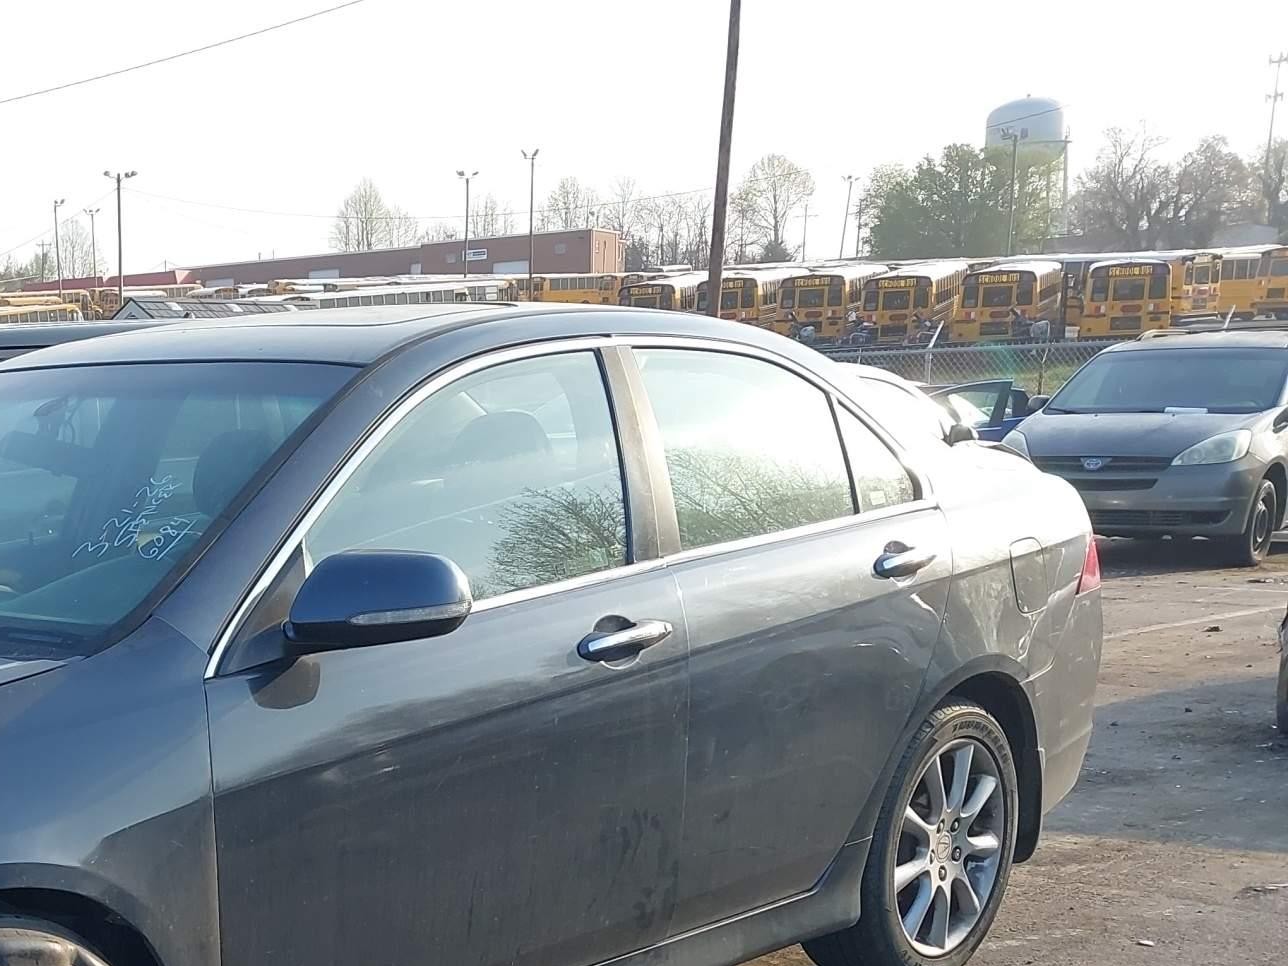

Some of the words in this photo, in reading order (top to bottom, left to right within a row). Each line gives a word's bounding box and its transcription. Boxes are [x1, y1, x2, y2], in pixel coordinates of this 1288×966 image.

[1109, 266, 1140, 277] SCHOOL
[1141, 265, 1153, 274] BUS
[878, 279, 905, 289] SCHOOL
[906, 277, 917, 288] BUS
[979, 274, 1008, 284] SCHOOL
[1009, 272, 1020, 282] BUS
[71, 474, 173, 558] 3-21-26
[138, 516, 191, 559] 6084
